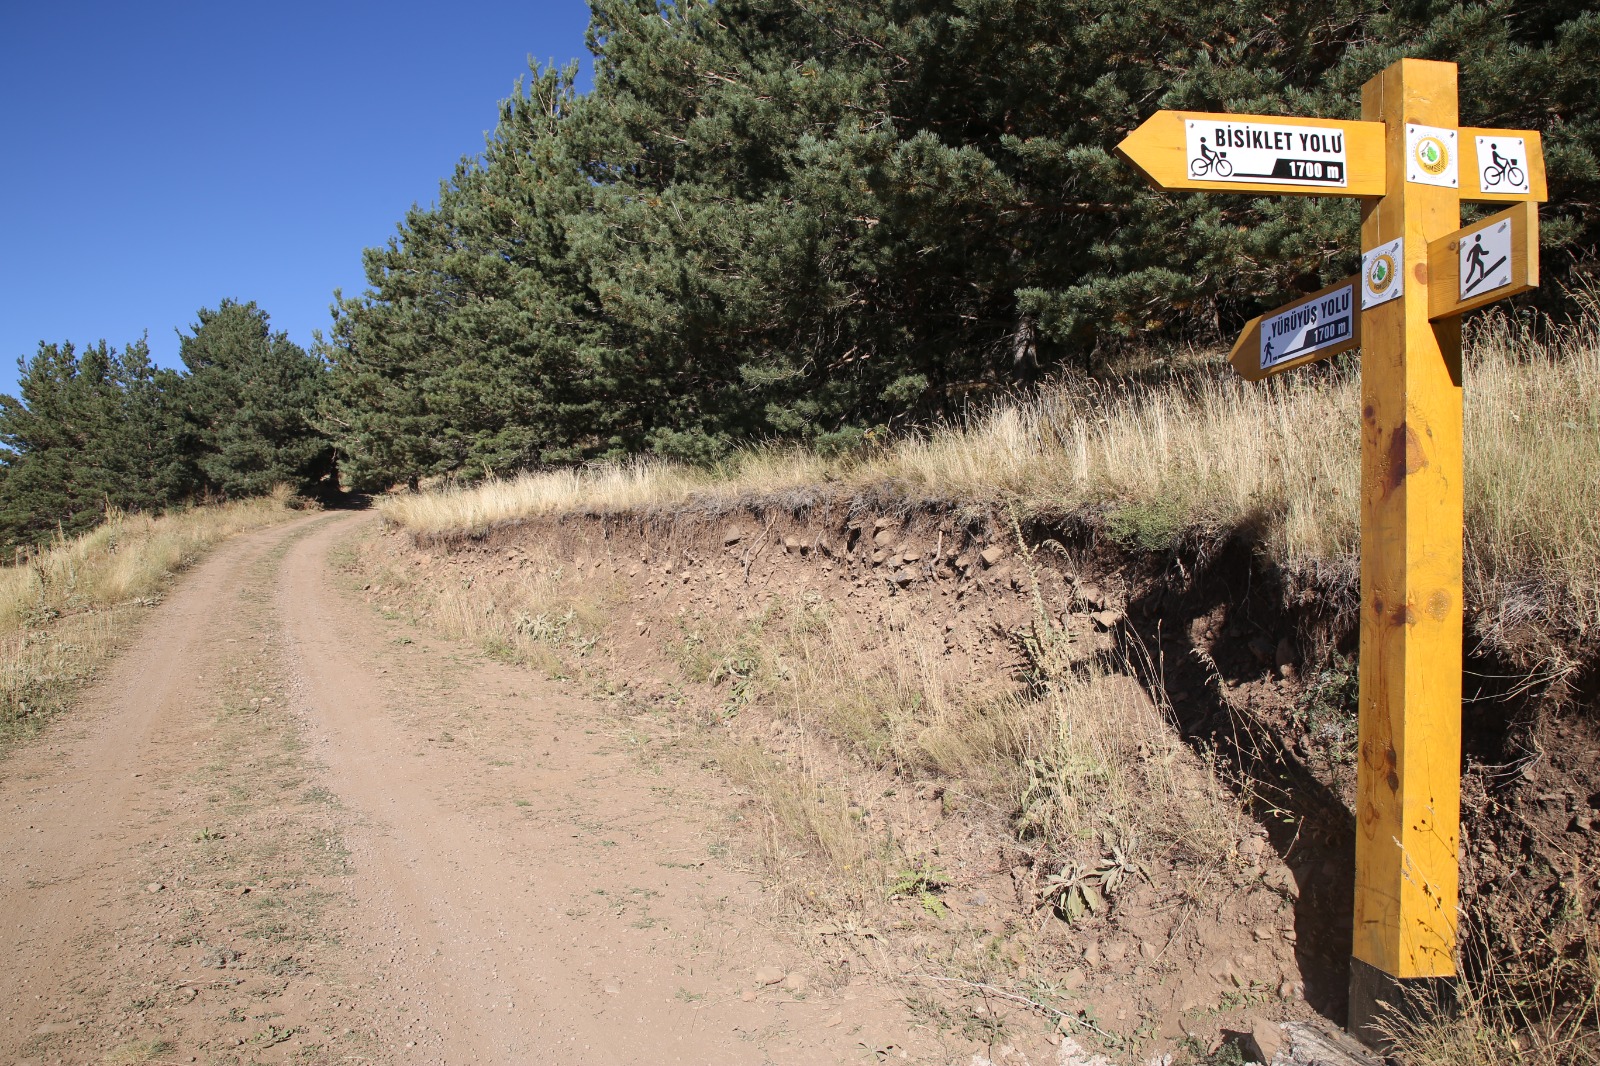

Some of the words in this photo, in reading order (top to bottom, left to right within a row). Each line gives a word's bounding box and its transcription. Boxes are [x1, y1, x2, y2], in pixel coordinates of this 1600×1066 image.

[1215, 125, 1293, 150] BİSİKLET
[1299, 133, 1342, 153] YOLU
[1289, 161, 1322, 178] 1700
[1327, 166, 1339, 178] m
[1272, 305, 1317, 338] YÜRÜYÜŞ
[1321, 293, 1349, 318] YOLU
[1315, 324, 1335, 342] 1700
[1338, 322, 1346, 334] m
